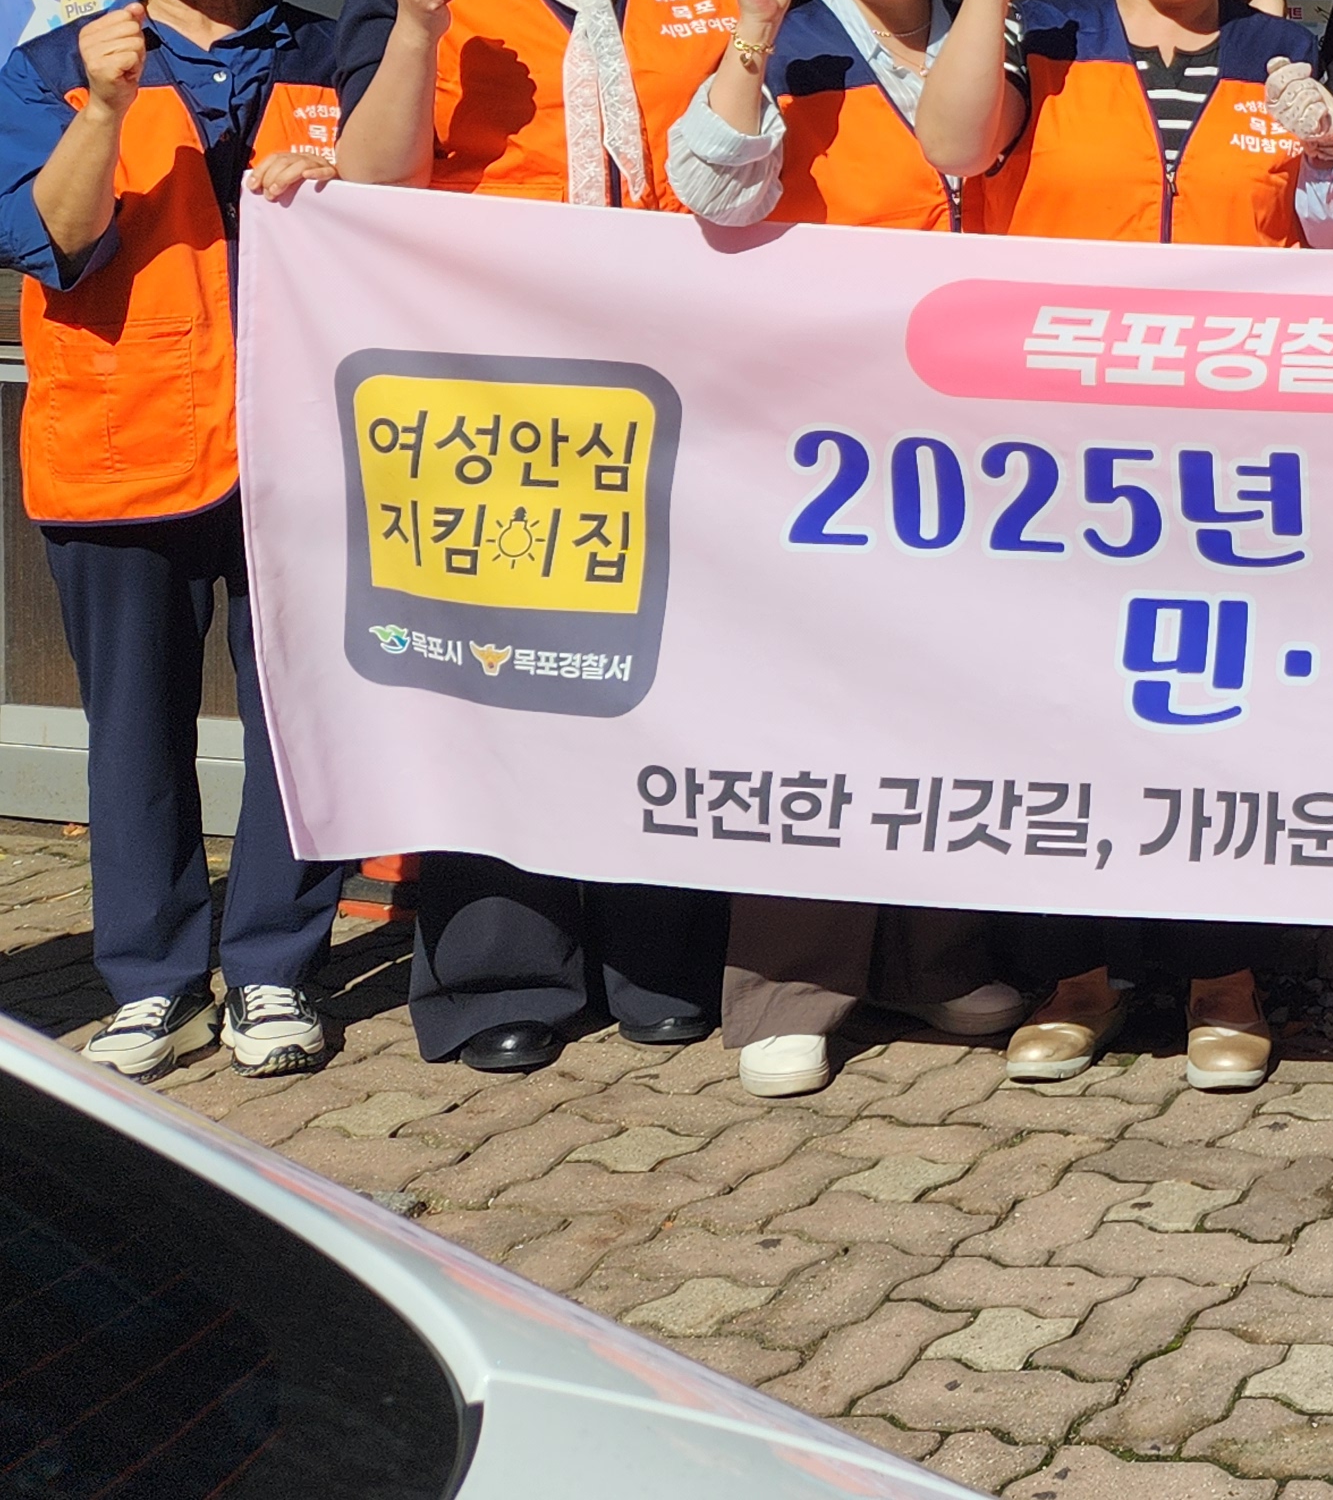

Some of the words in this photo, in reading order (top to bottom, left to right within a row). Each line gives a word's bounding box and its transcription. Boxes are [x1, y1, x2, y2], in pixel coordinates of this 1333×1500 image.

[368, 409, 639, 493] 여성안심
[786, 429, 1309, 570] 2025년
[411, 631, 464, 666] 목포시
[513, 647, 634, 682] 목포경찰서
[635, 762, 853, 852] 안전한
[869, 775, 1114, 872] 귀갓길,
